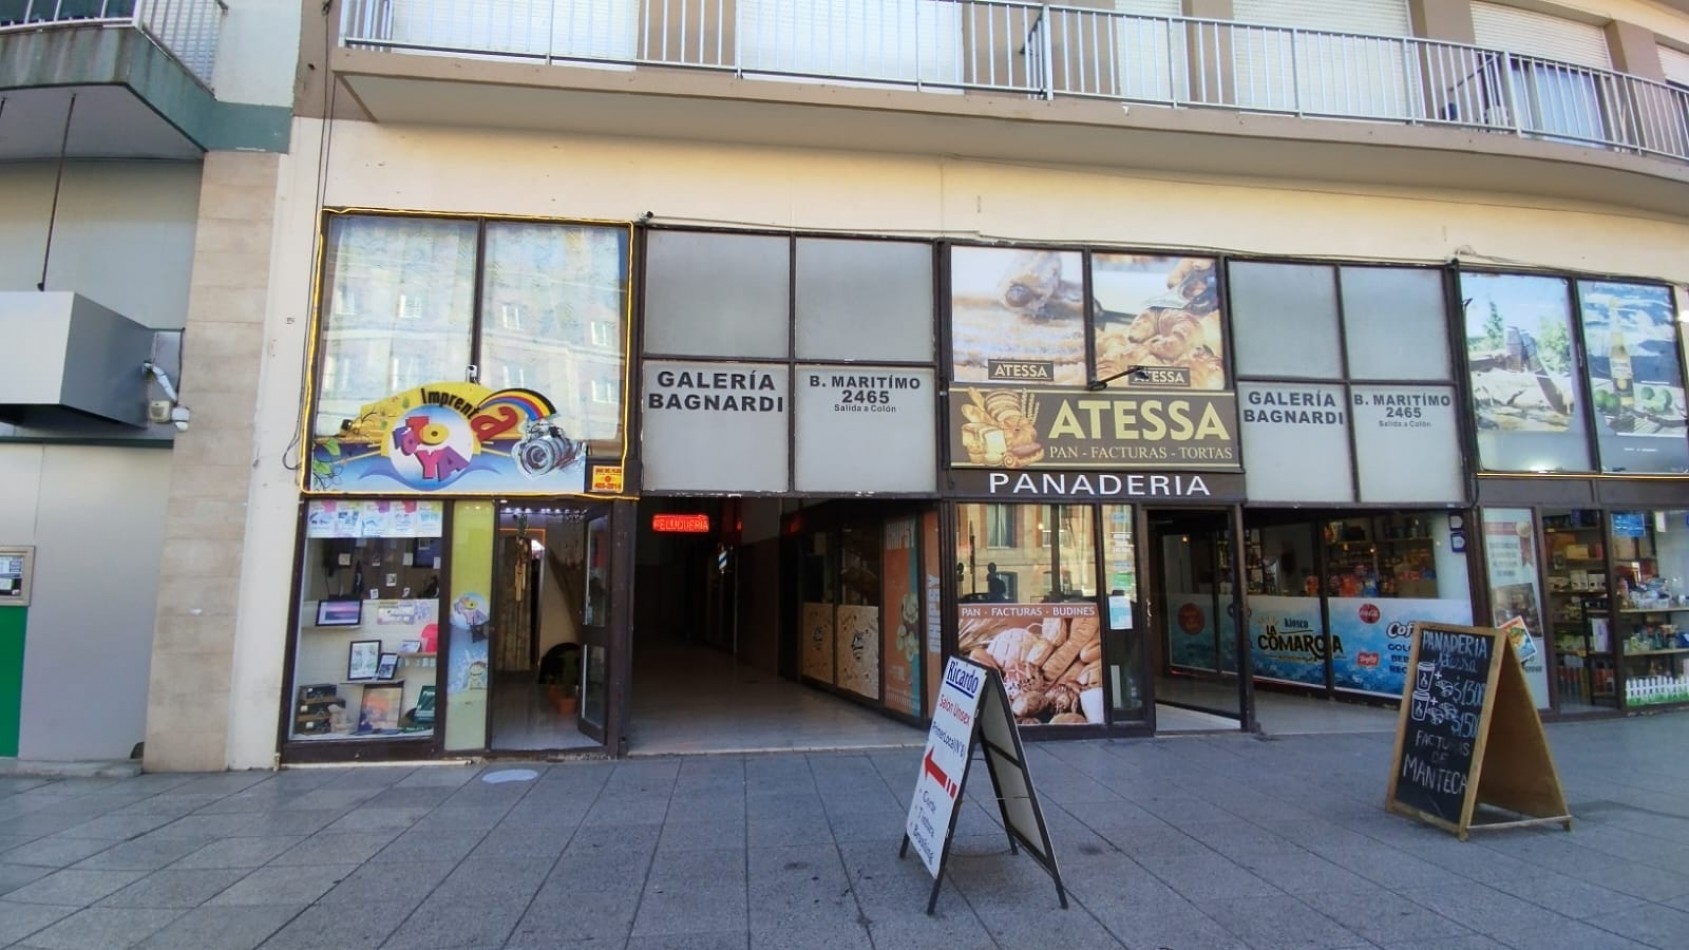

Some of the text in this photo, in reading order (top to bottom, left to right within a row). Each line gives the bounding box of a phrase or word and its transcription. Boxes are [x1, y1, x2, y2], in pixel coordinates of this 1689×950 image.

[994, 362, 1048, 378] ATESSA
[656, 369, 776, 391] GALERÍA
[809, 375, 827, 389] B.
[648, 393, 783, 413] BAGNARDI
[841, 389, 890, 404] 2465
[1248, 390, 1336, 407] GALERÍA
[1354, 394, 1369, 406] B.
[834, 403, 897, 414] Salida a Colón
[1385, 406, 1422, 418] 2465
[1047, 399, 1231, 441] ATESSA
[1243, 409, 1344, 426] BAGNARDI
[1050, 445, 1233, 460] PAN FACTURAS TORTAS
[988, 472, 1211, 496] PANADERIA
[961, 606, 1095, 617] PAN FACTURAS BUDINES
[1266, 624, 1277, 636] LA
[1422, 630, 1488, 659] PANADERIA
[946, 660, 980, 694] Ricardo
[1402, 753, 1468, 795] MANTECA
